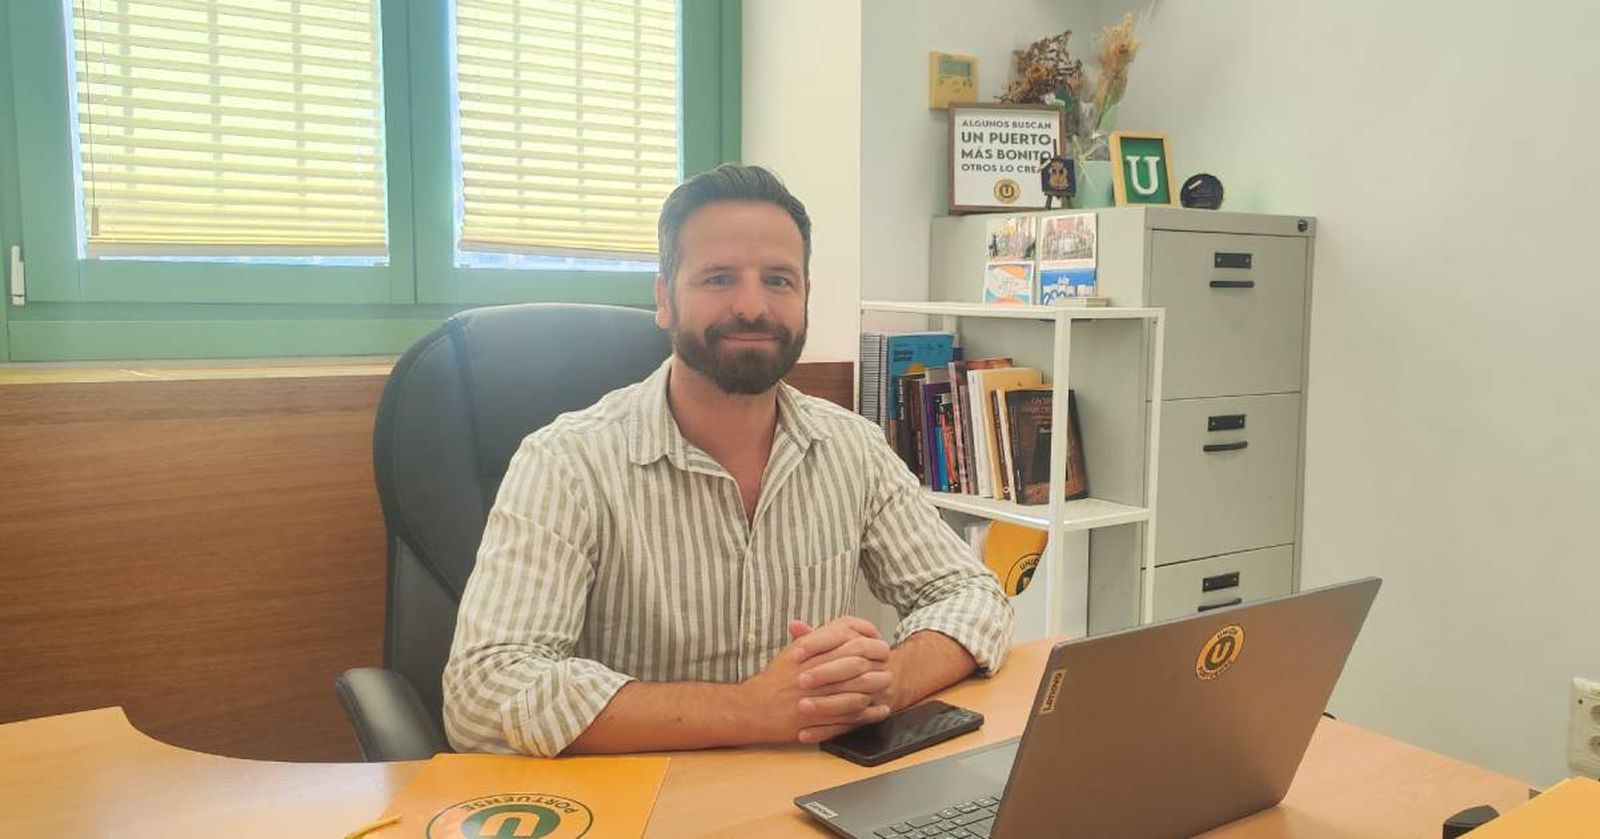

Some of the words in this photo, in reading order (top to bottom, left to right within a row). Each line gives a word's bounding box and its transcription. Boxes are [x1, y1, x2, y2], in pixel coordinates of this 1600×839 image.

[962, 119, 1009, 128] ALGUNOS
[1012, 121, 1051, 129] BUSCAN
[961, 132, 983, 143] UN
[989, 132, 1051, 145] PUERTO
[961, 146, 992, 159] MÁS
[997, 149, 1051, 161] BONITO
[961, 163, 997, 172] OTROS
[1000, 164, 1014, 173] LO
[1125, 155, 1160, 195] U
[461, 795, 579, 814] PORTUENSE
